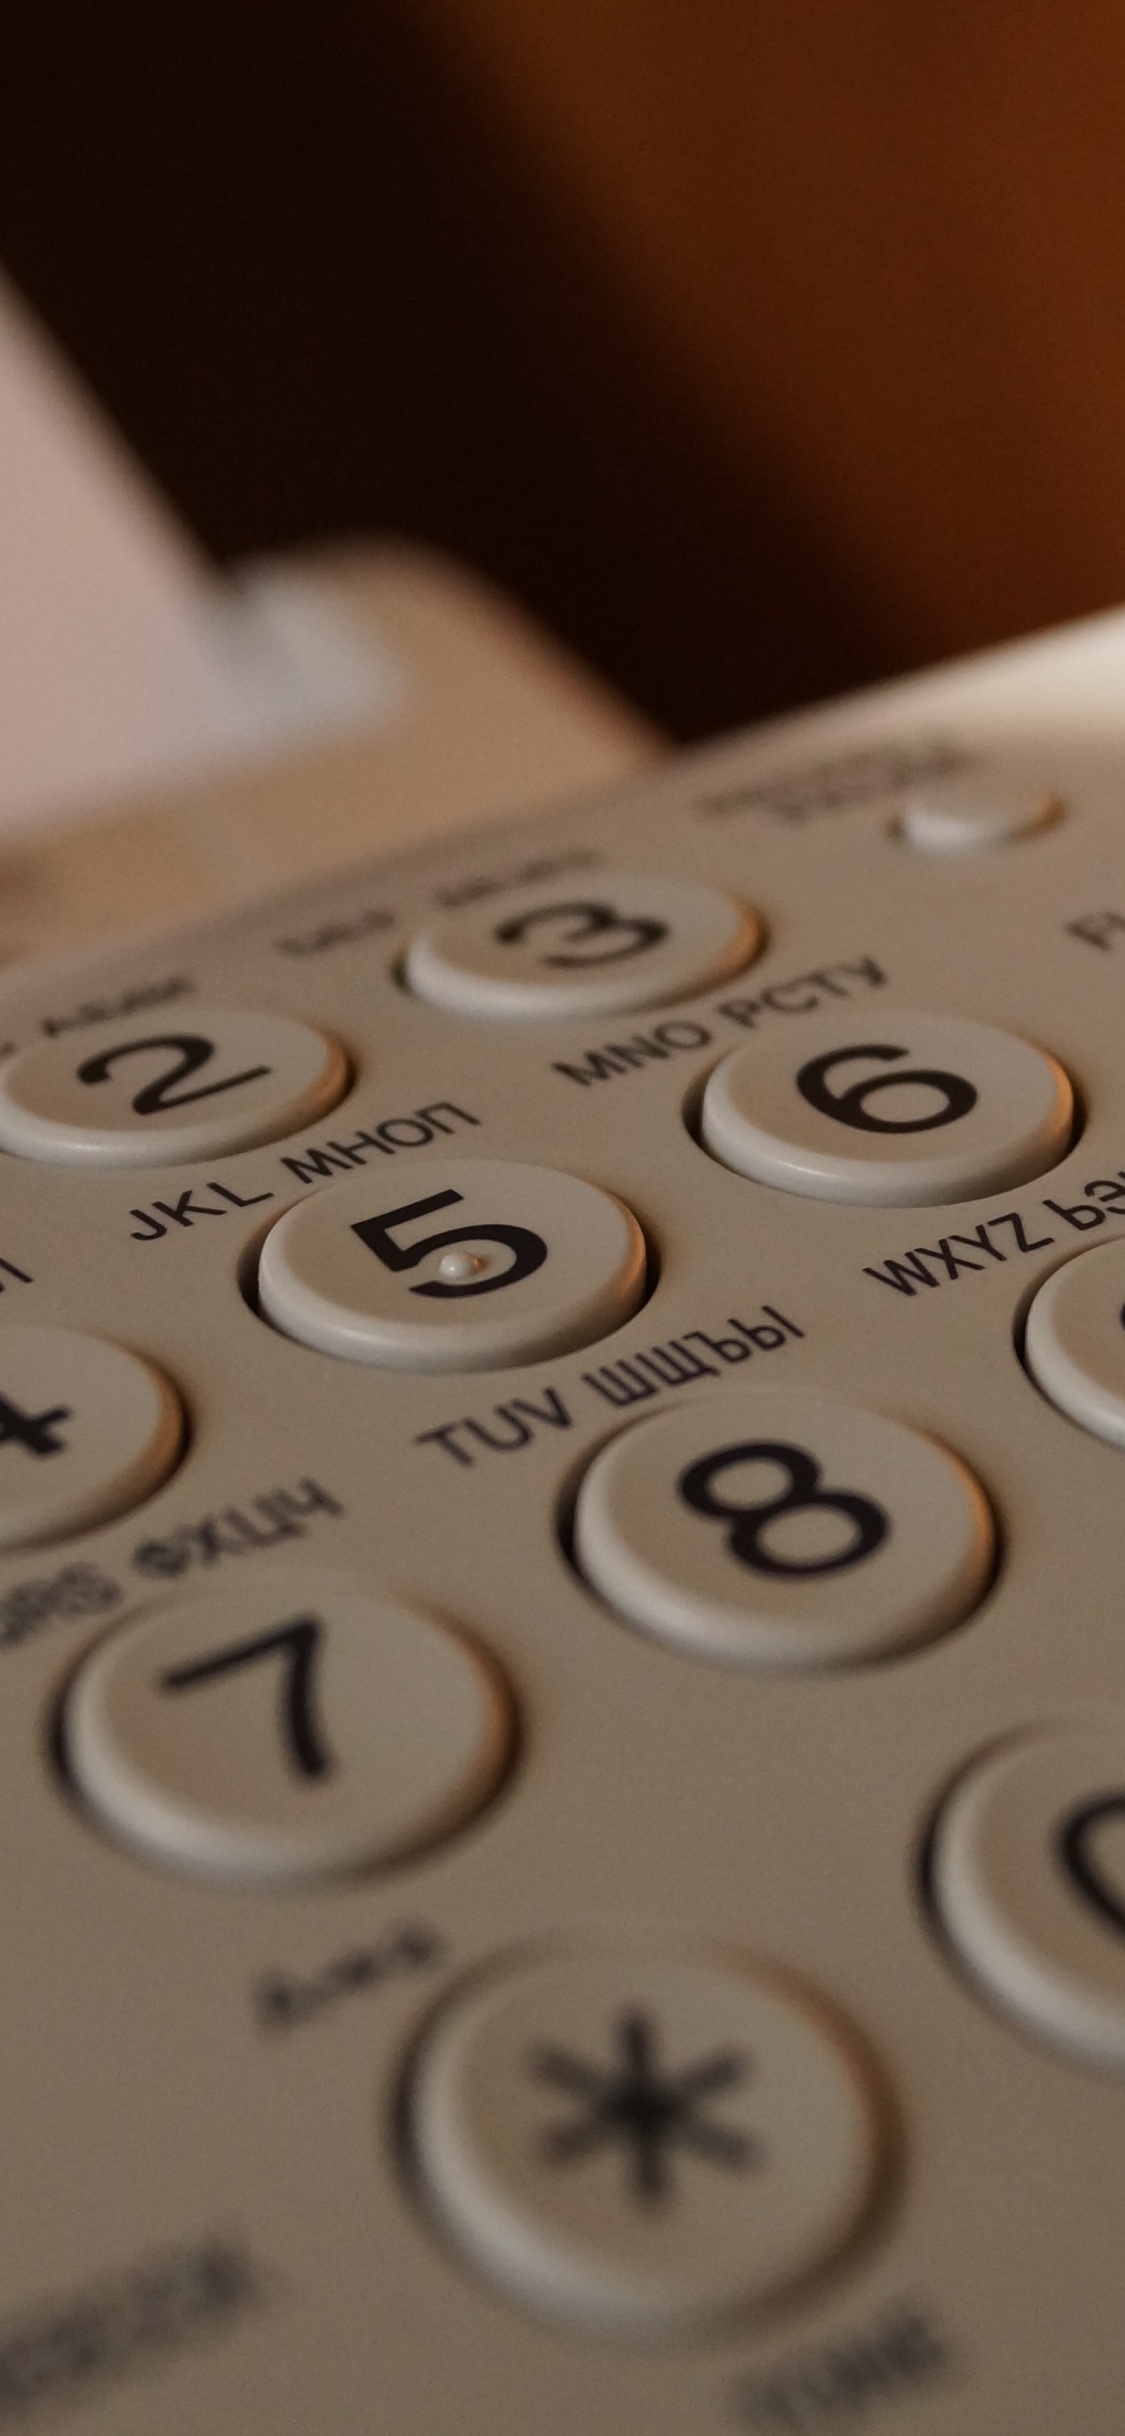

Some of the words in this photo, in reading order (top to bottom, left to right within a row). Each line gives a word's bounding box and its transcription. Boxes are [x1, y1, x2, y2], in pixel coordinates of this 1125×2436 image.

[494, 902, 670, 969] 3
[76, 1034, 271, 1117] 2
[551, 1020, 713, 1087] MNO
[795, 1044, 979, 1135] 6
[129, 1182, 275, 1242] JKL
[279, 1101, 481, 1184] МНОП
[350, 1188, 549, 1299] 5
[862, 1212, 1055, 1297] WXYZ
[415, 1386, 573, 1468] TUV
[580, 1304, 805, 1407] ШЩЪЫ
[676, 1440, 891, 1582] 8
[158, 1615, 333, 1784] 7
